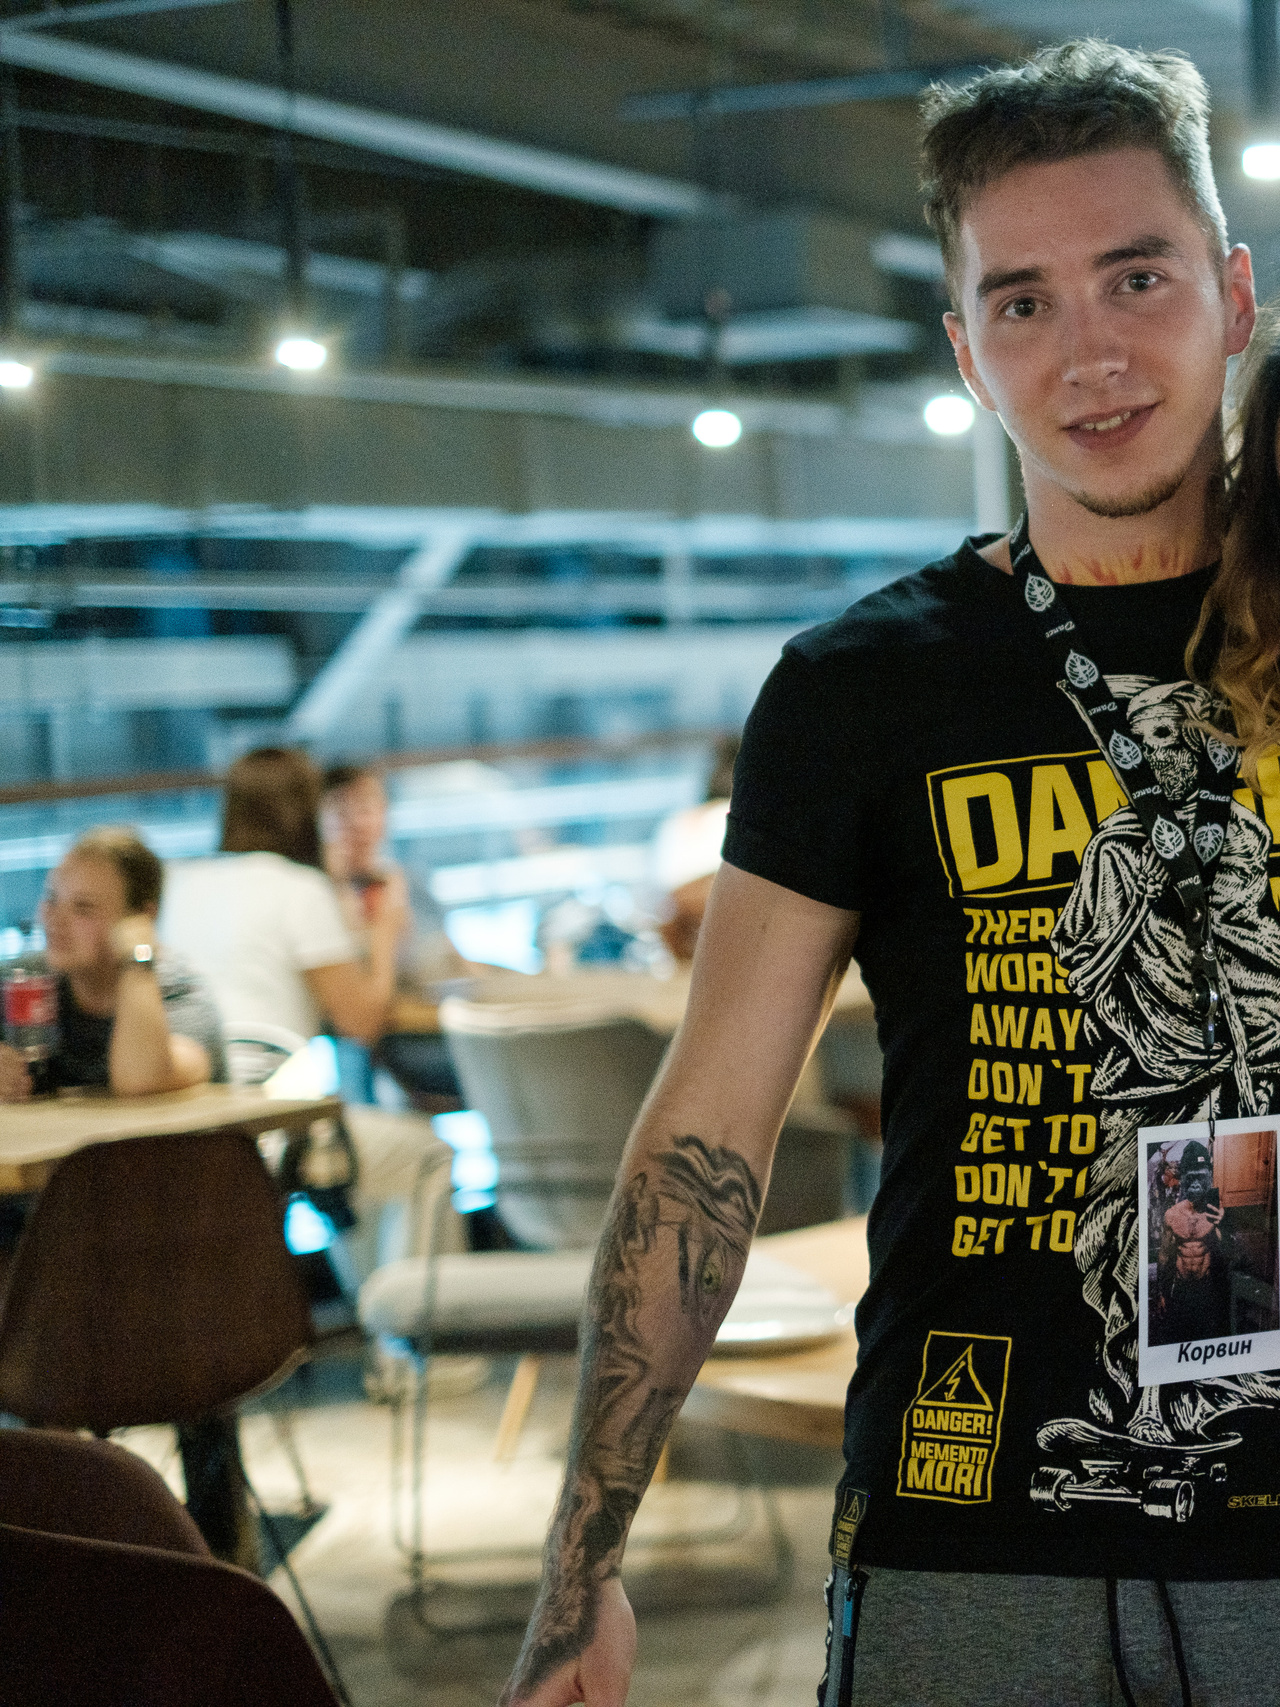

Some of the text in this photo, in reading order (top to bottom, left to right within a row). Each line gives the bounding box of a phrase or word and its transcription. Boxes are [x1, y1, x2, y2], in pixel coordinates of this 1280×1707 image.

[1199, 789, 1231, 802] Dance
[963, 907, 1064, 945] THER
[970, 1003, 1083, 1051] AWAY
[960, 1112, 1031, 1154] GET
[1043, 1114, 1097, 1155] TO
[951, 1215, 1015, 1257] GET
[1025, 1210, 1077, 1253] TO
[1177, 1339, 1253, 1365] Корвин
[912, 1408, 994, 1436] DANGER!
[910, 1440, 989, 1465] MEMENTO
[906, 1457, 985, 1497] MORI
